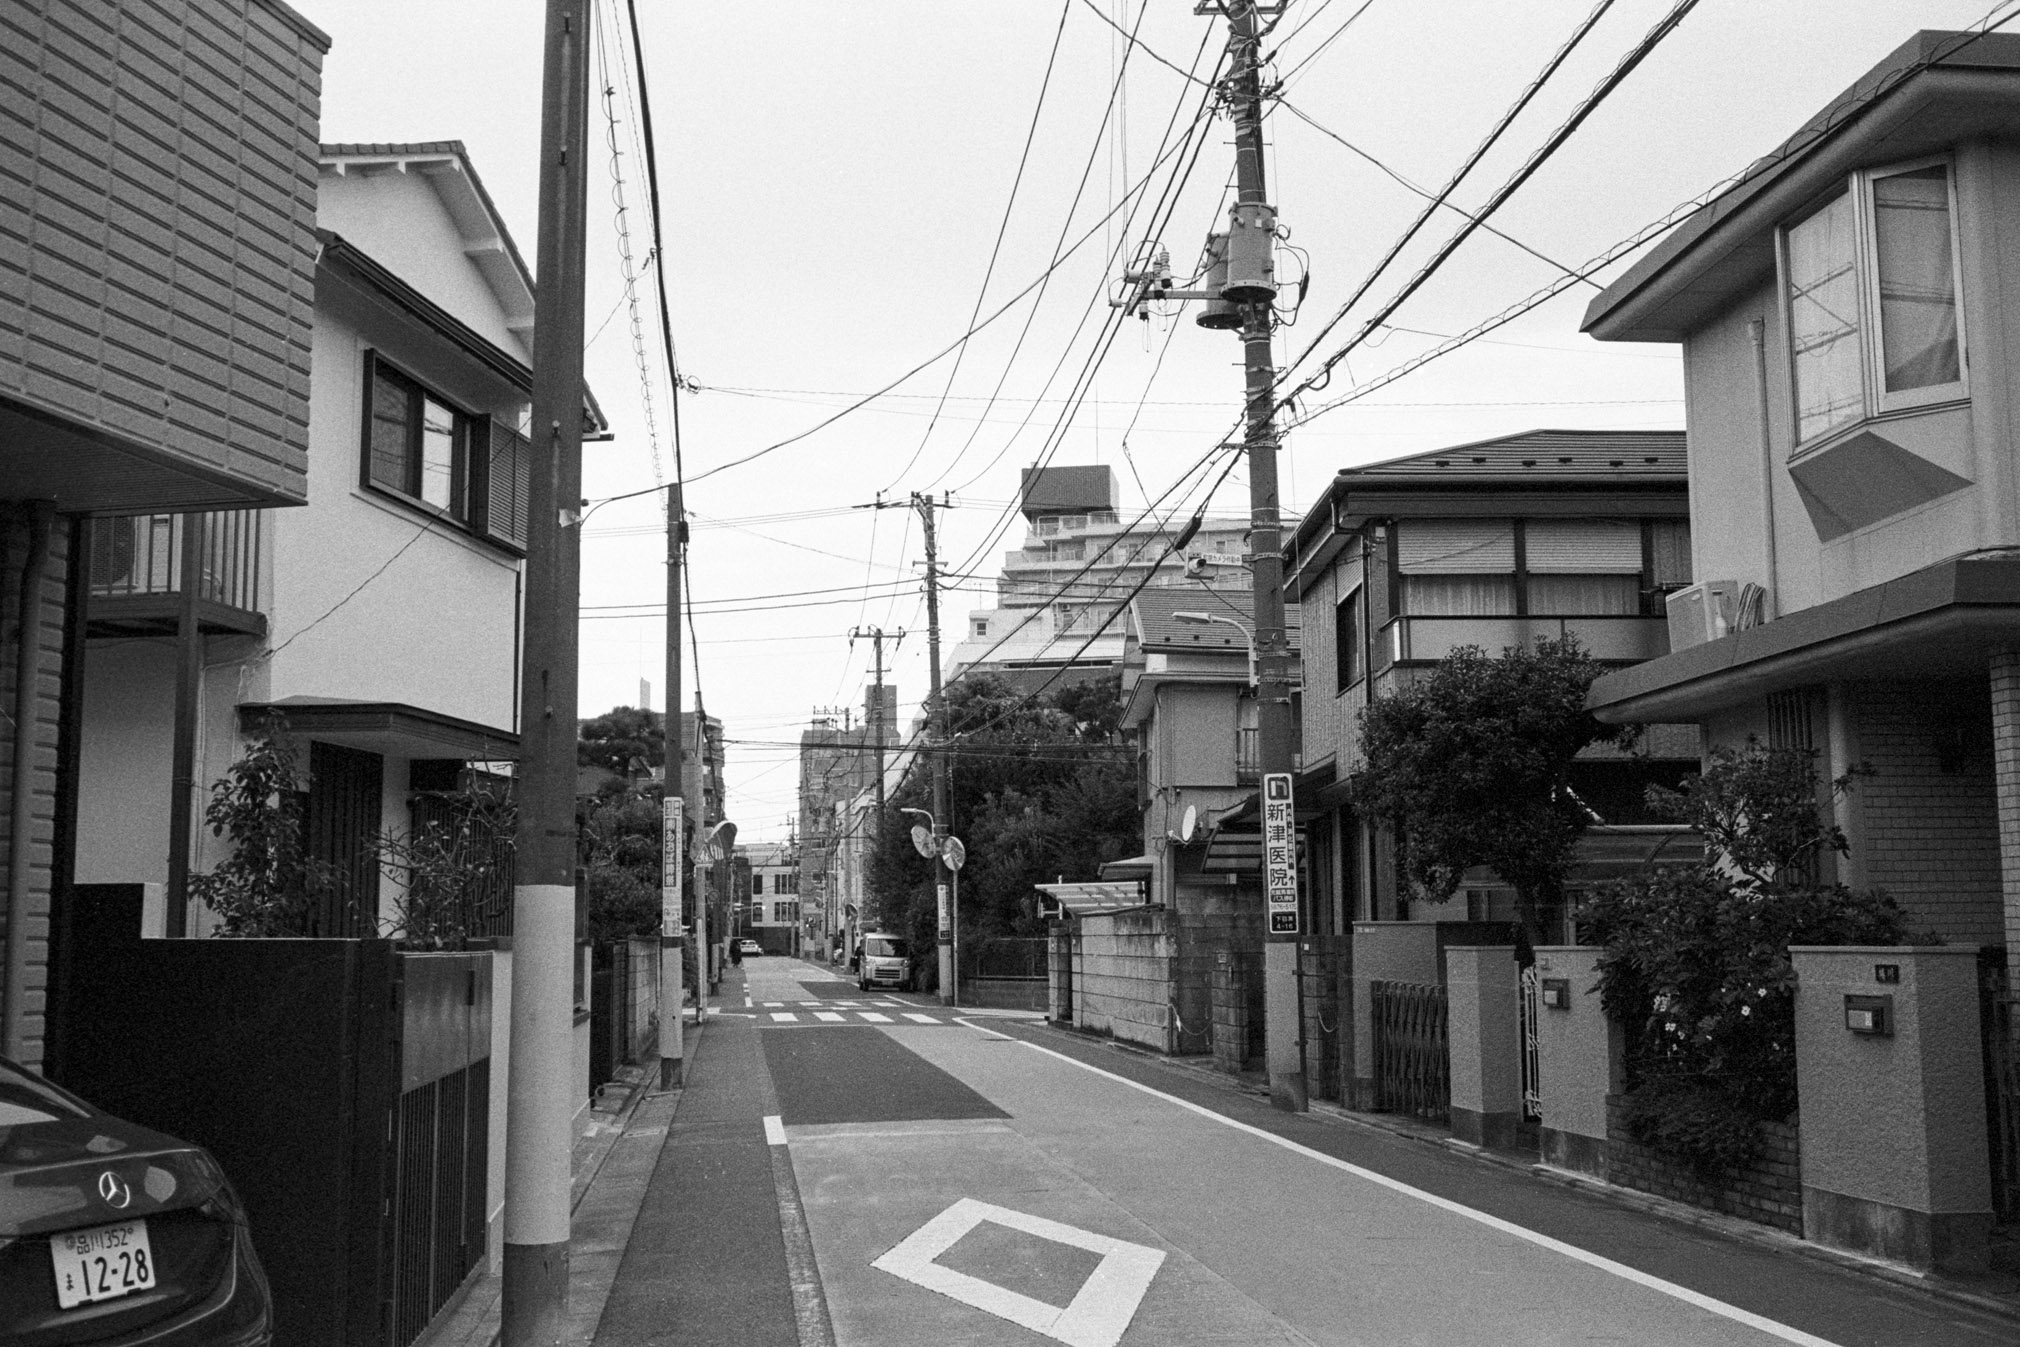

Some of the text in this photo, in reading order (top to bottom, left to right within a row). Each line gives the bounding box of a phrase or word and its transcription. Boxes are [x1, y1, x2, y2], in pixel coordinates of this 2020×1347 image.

[1267, 803, 1288, 887] 新津医院
[81, 1248, 149, 1296] 12-28
